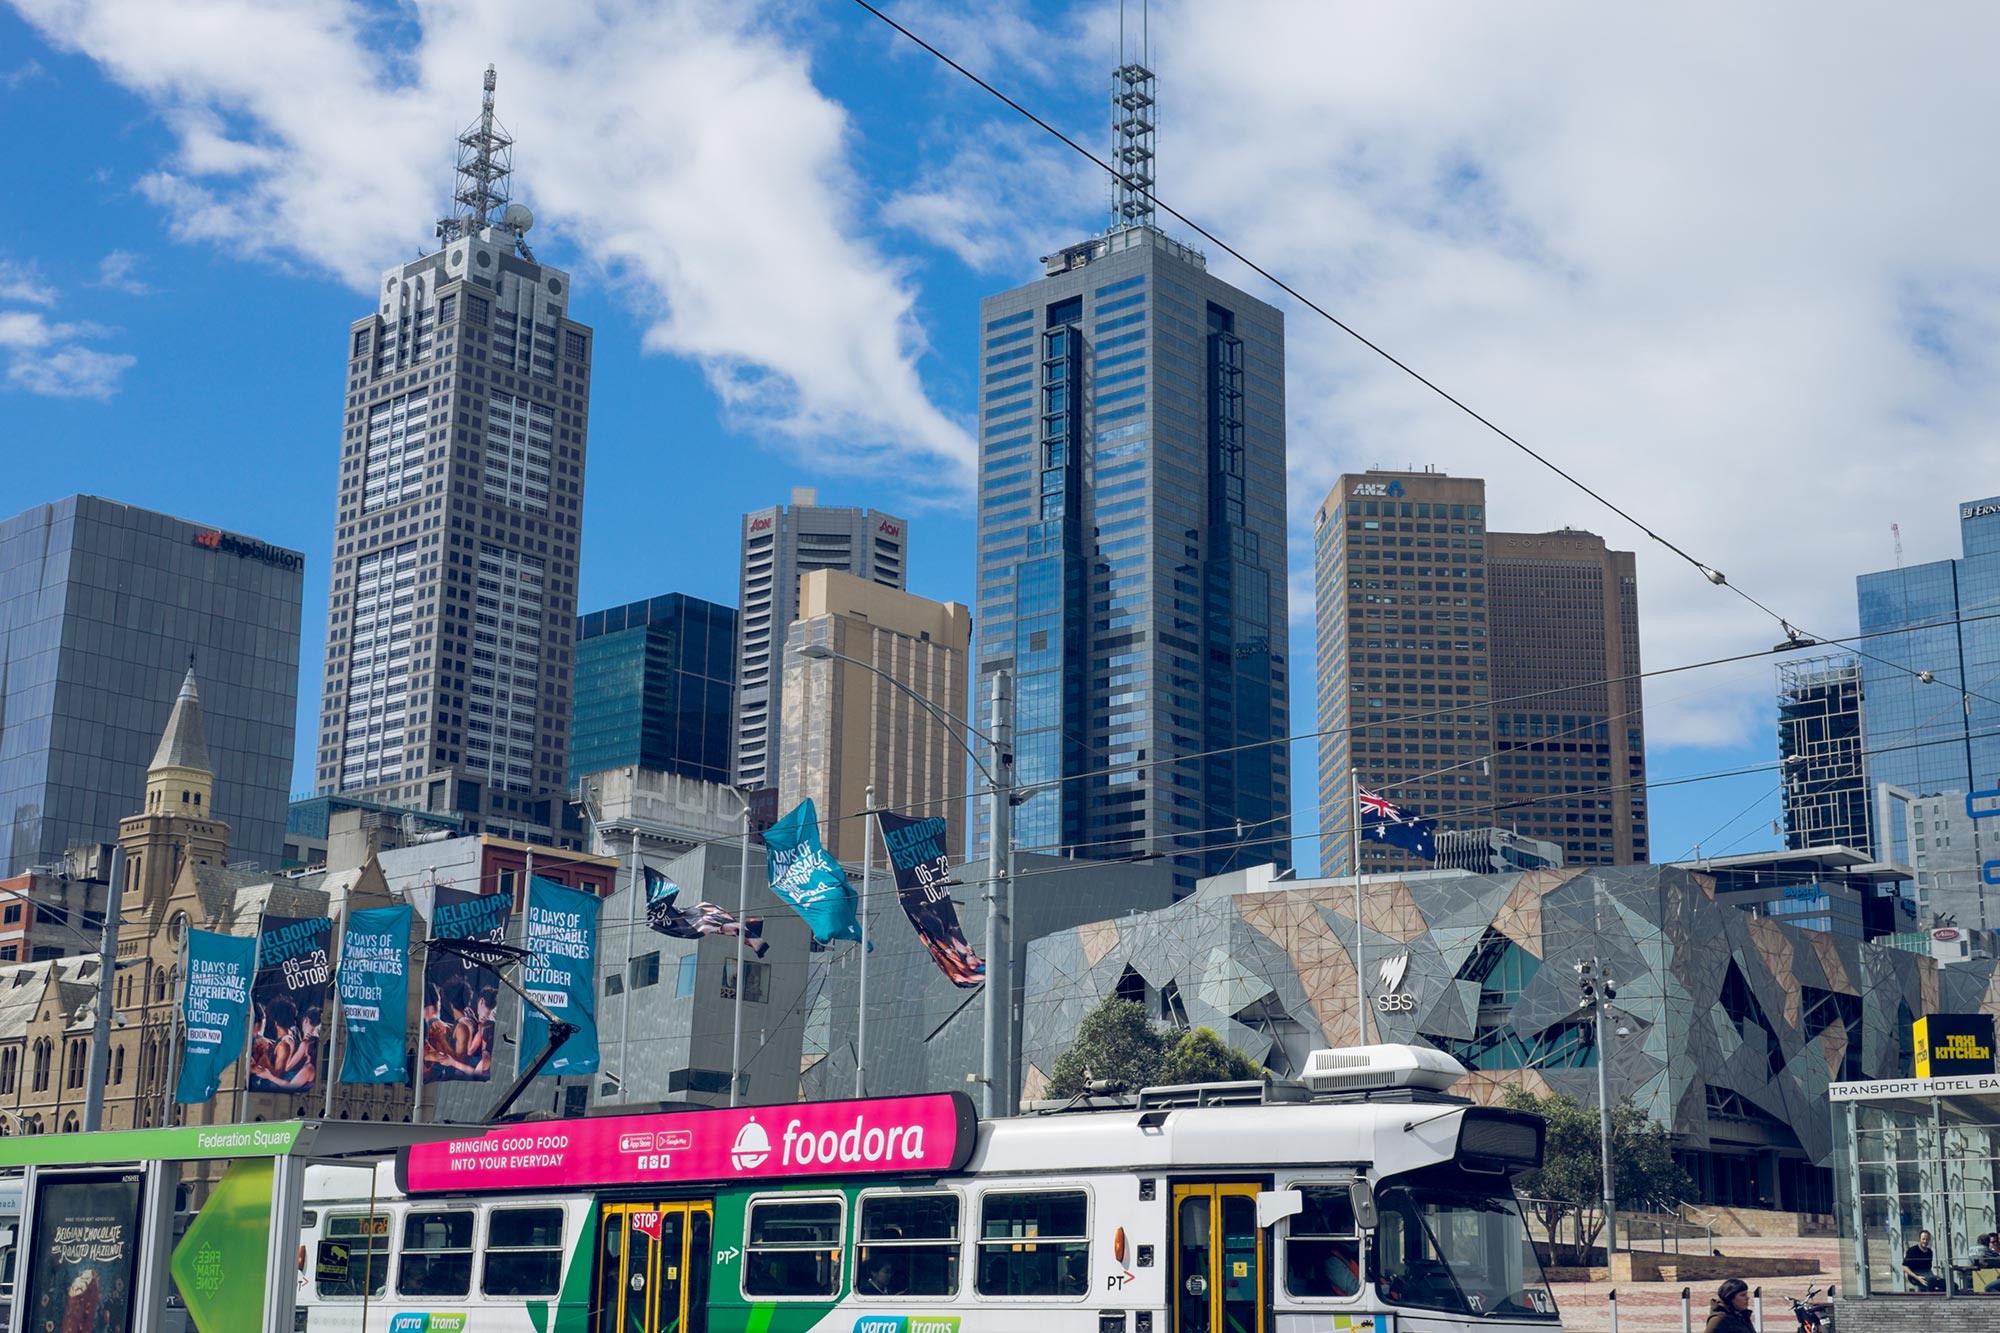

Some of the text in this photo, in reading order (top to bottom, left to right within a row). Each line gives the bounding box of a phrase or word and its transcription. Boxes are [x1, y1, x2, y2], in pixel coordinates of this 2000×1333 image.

[1353, 483, 1387, 496] ANZ
[1507, 539, 1598, 551] SOFITEL
[541, 909, 566, 927] DAYS
[567, 913, 580, 928] OF
[355, 932, 377, 947] DAYS
[380, 934, 392, 947] OF
[529, 922, 588, 944] UNMISSABLE
[527, 937, 589, 959] EXPERIENCES
[201, 960, 225, 976] DAYS
[227, 963, 240, 975] OF
[342, 959, 402, 976] EXPERIENCES
[527, 953, 550, 968] THIS
[341, 972, 363, 986] THIS
[525, 968, 571, 986] OCTOBER
[189, 984, 246, 1004] EXPERIENCES
[341, 985, 382, 1000] OCTOBER
[547, 993, 565, 1004] NOW
[188, 996, 209, 1011] THIS
[1378, 994, 1413, 1011] SBS
[187, 1010, 229, 1026] OCTOBER
[190, 1029, 207, 1040] BOOK
[1946, 1034, 1976, 1047] TAXI
[1935, 1047, 1990, 1060] KITCHEN
[1830, 1082, 1918, 1096] TRANSPORT
[1924, 1080, 1974, 1091] HOTEL
[198, 1130, 291, 1149] Federation Square
[449, 1136, 568, 1154] BRINGING GOOD FOOD
[630, 1139, 651, 1149] App Store
[782, 1115, 925, 1166] foodora
[451, 1154, 564, 1171] INTO YOUR EVERYDAY
[633, 1213, 658, 1228] STOP
[83, 1225, 122, 1243] CHOCOLATE
[59, 1244, 89, 1263] ROASTED
[90, 1242, 124, 1262] HAZELNUT
[395, 1315, 461, 1333] yarra trams
[911, 1319, 953, 1333] trams
